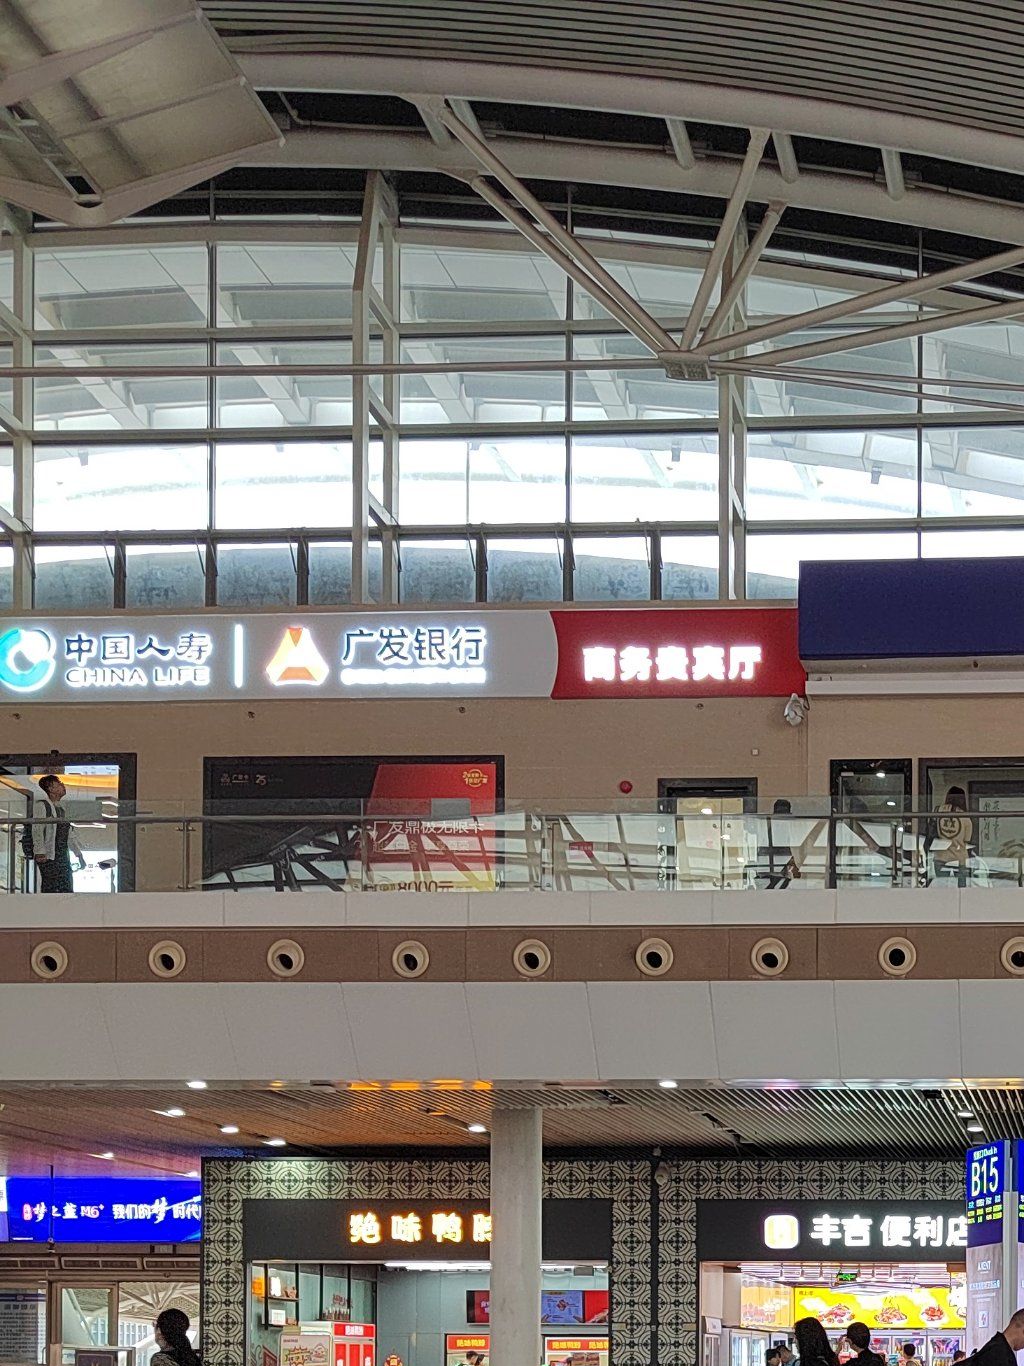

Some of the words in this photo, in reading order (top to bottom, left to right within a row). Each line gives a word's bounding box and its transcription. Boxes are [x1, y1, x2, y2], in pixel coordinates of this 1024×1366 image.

[65, 632, 212, 664] 中国人寿
[342, 627, 486, 662] 广发银行
[65, 667, 146, 685] CHINA
[153, 666, 210, 685] LIFE
[583, 645, 762, 682] 商务贵宾厅
[971, 1156, 999, 1197] B15
[811, 1214, 873, 1247] 丰吉
[880, 1214, 968, 1247] 便利店
